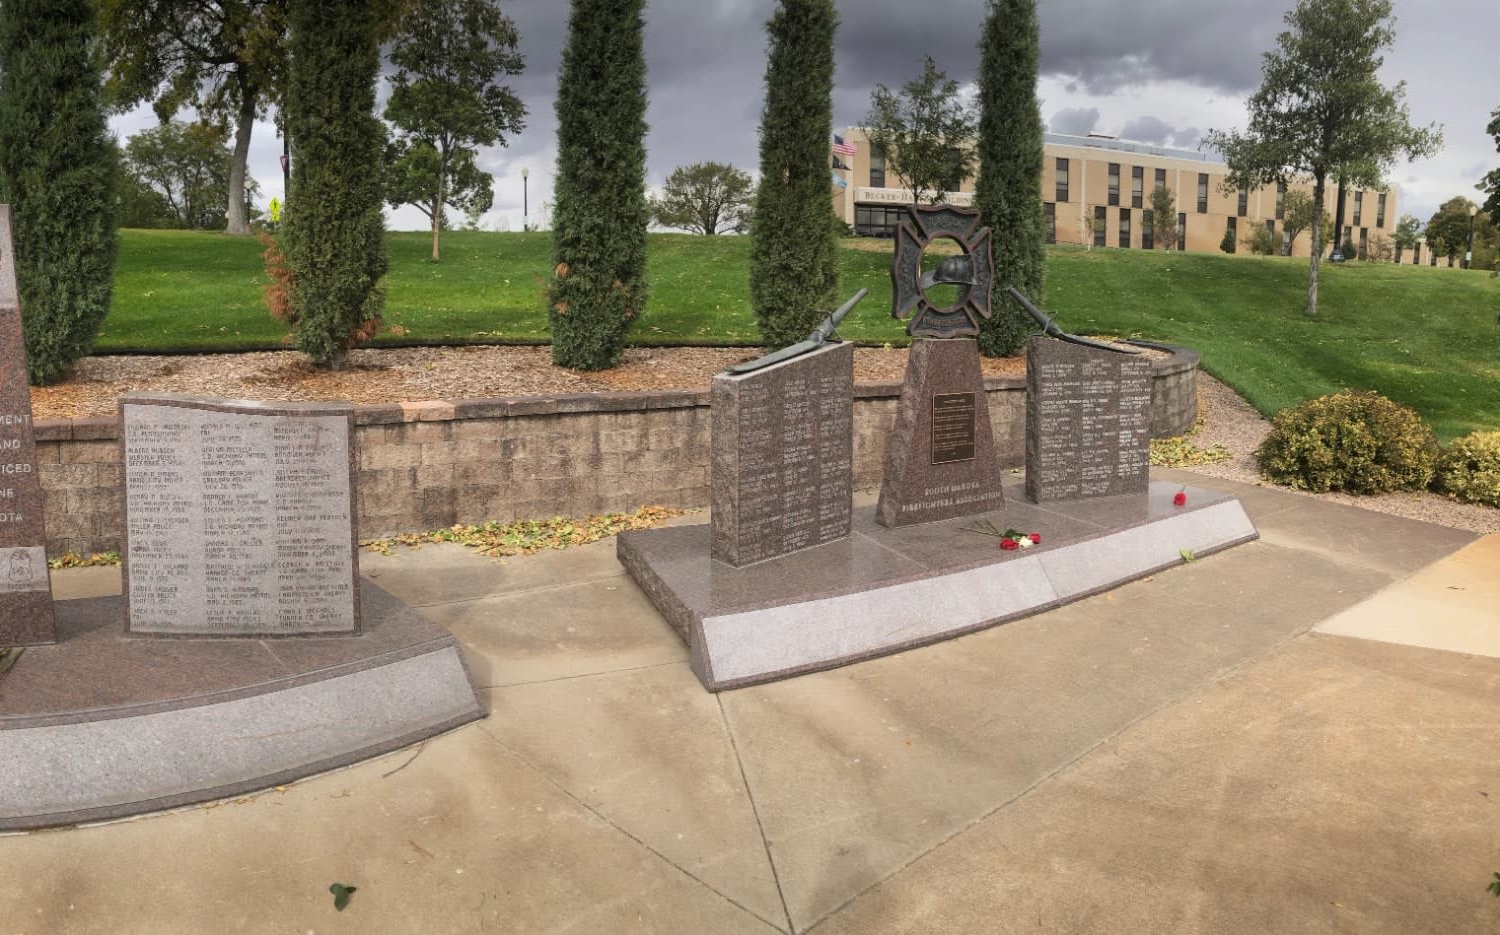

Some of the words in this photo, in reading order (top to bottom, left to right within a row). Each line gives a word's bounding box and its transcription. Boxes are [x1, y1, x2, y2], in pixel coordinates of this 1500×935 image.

[924, 486, 950, 496] SOUTH
[951, 481, 979, 492] DAKOTA
[955, 491, 1001, 504] ASSOCIATION
